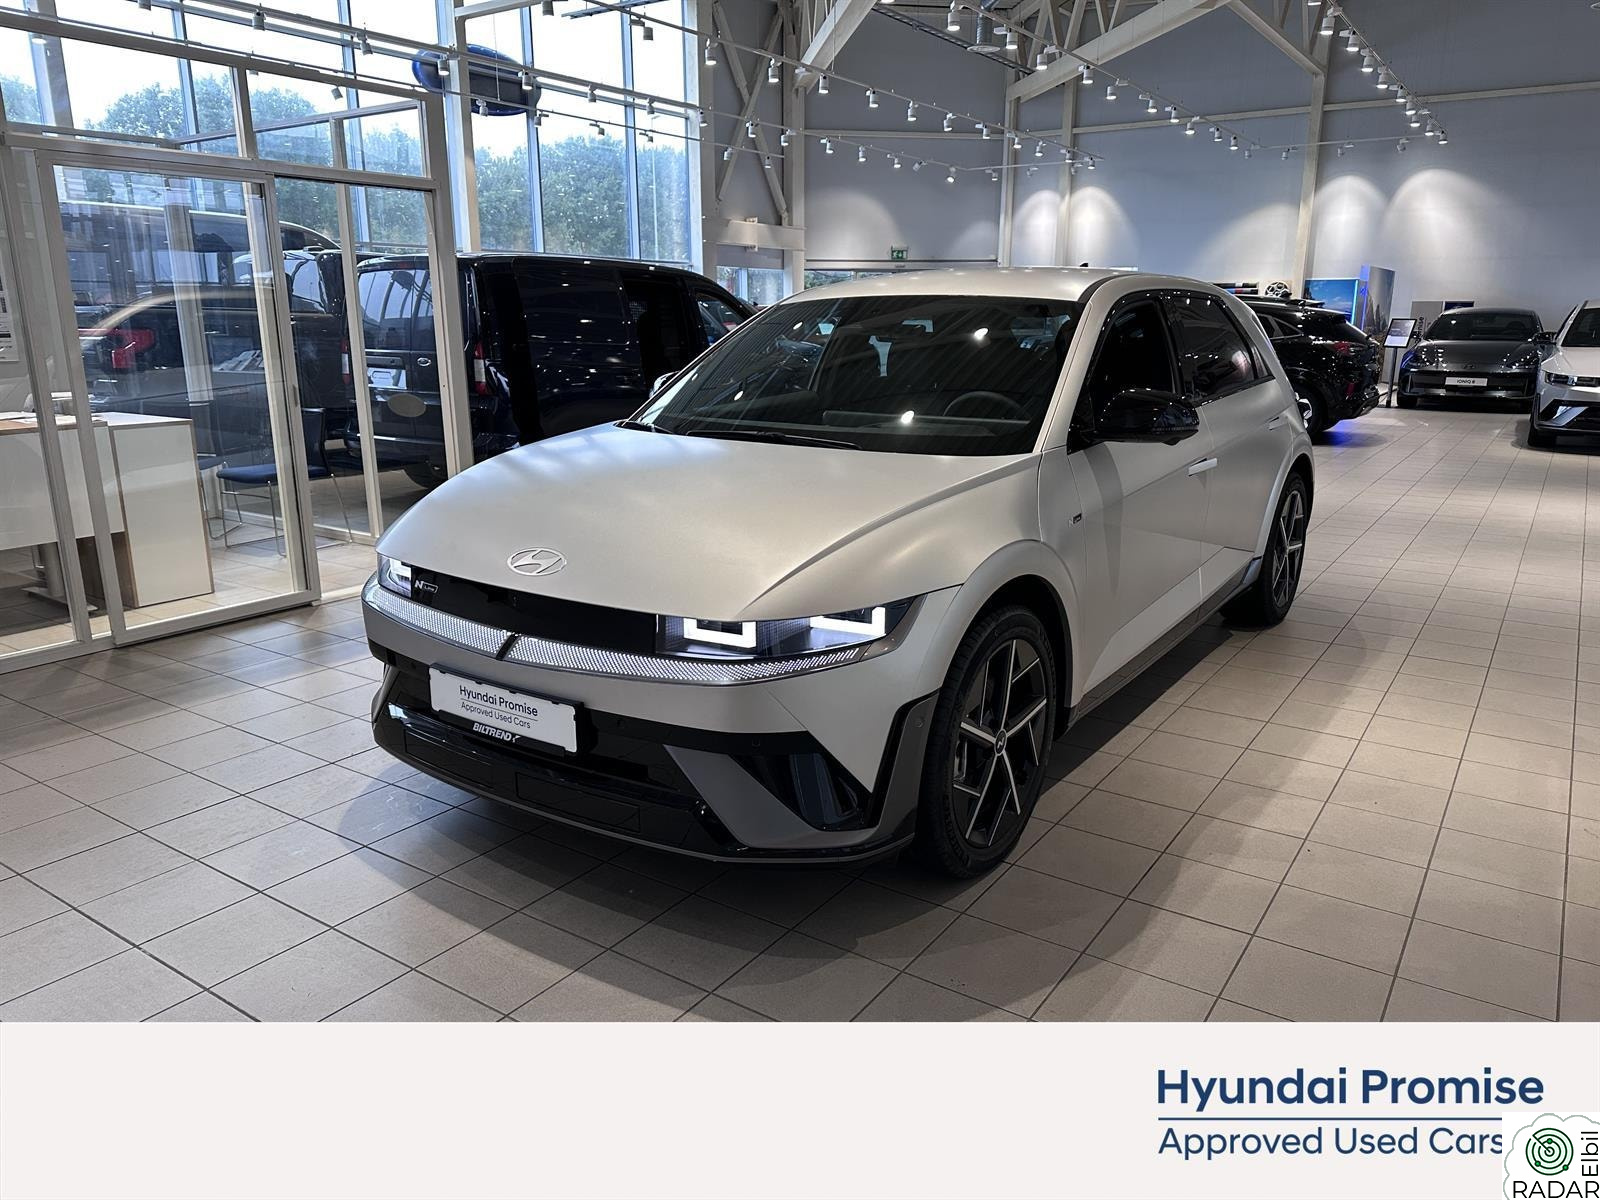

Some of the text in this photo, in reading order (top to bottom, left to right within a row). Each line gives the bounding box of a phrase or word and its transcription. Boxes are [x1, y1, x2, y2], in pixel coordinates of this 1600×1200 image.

[459, 685, 538, 717] Hyundai Promise
[461, 701, 531, 729] Approved Used Cars
[473, 722, 512, 741] BILTREND
